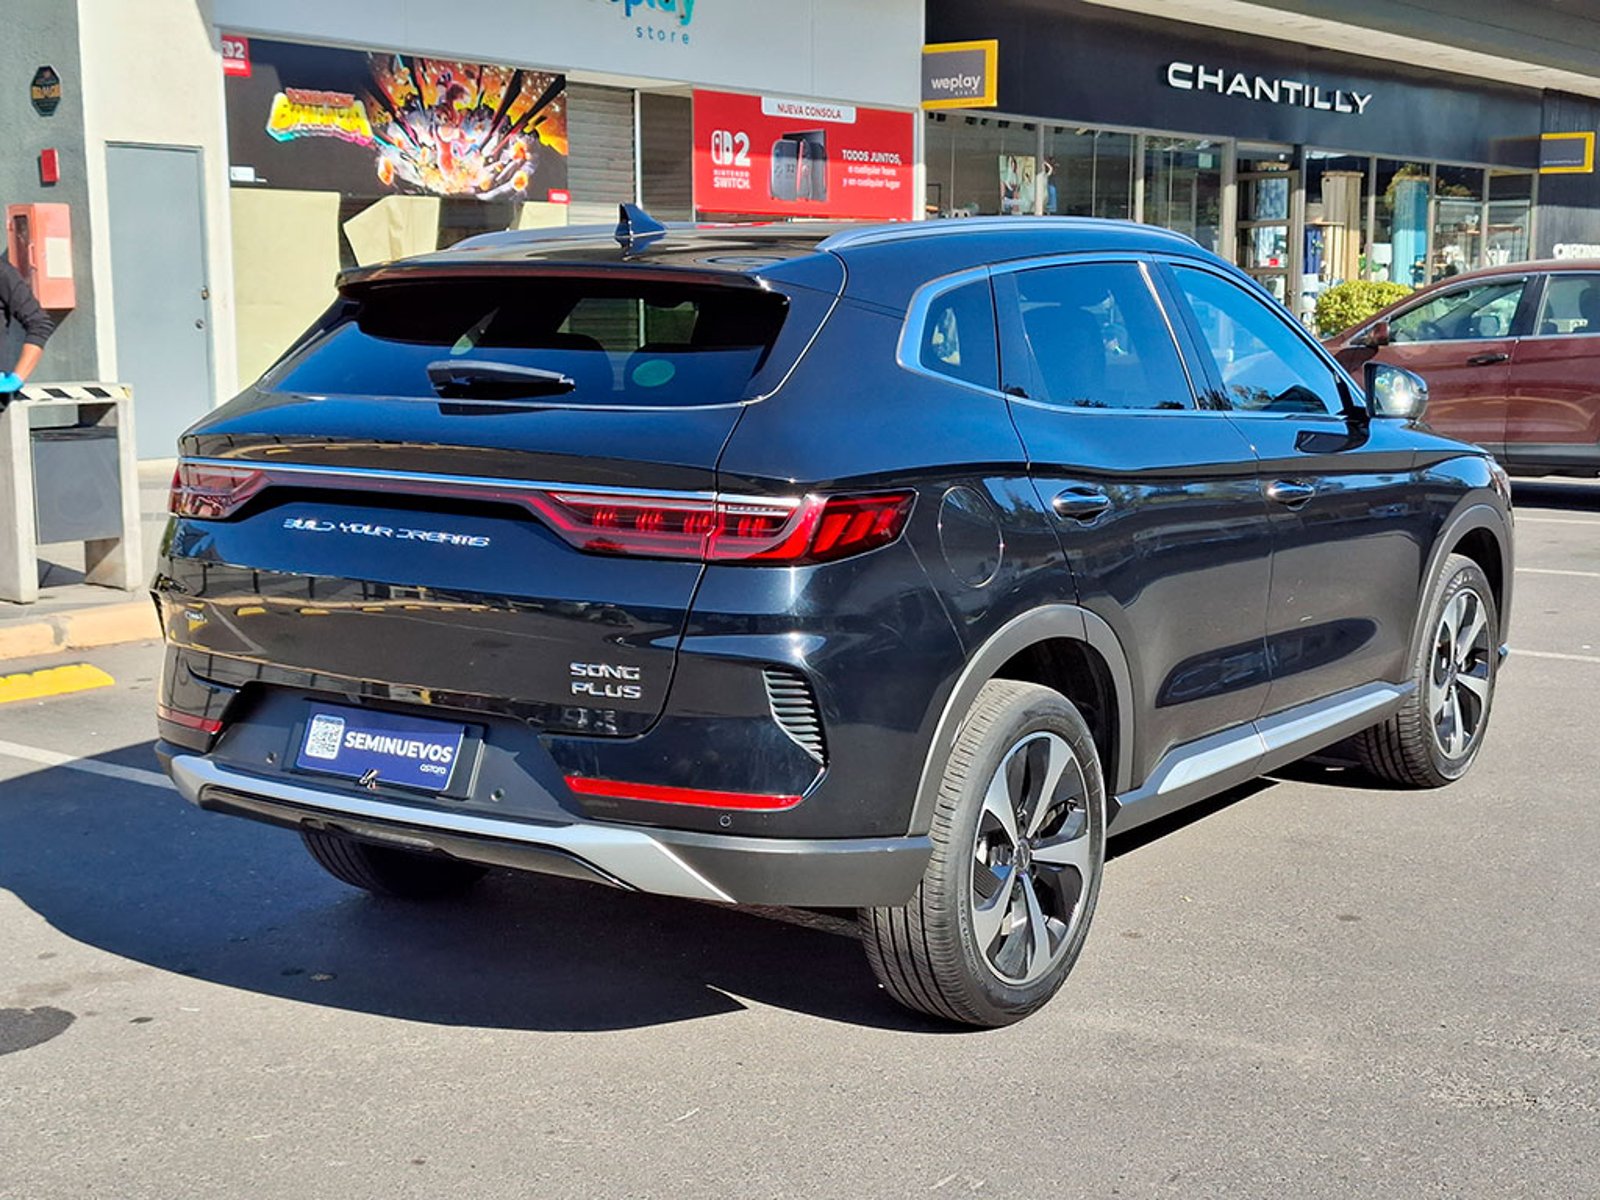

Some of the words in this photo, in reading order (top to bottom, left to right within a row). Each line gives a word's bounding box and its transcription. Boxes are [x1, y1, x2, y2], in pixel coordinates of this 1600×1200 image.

[636, 26, 690, 44] store
[930, 73, 981, 92] weplay
[1168, 62, 1373, 114] CHANTILLY
[777, 103, 804, 116] NUEVA
[804, 106, 842, 119] CONSOLA
[842, 149, 869, 161] TODOS
[283, 518, 335, 531] BUILD
[339, 521, 393, 538] YOUR
[396, 528, 490, 547] DREAMS
[569, 662, 640, 680] SONG
[571, 681, 641, 699] PLUS
[344, 731, 453, 763] SEMINUEVOS
